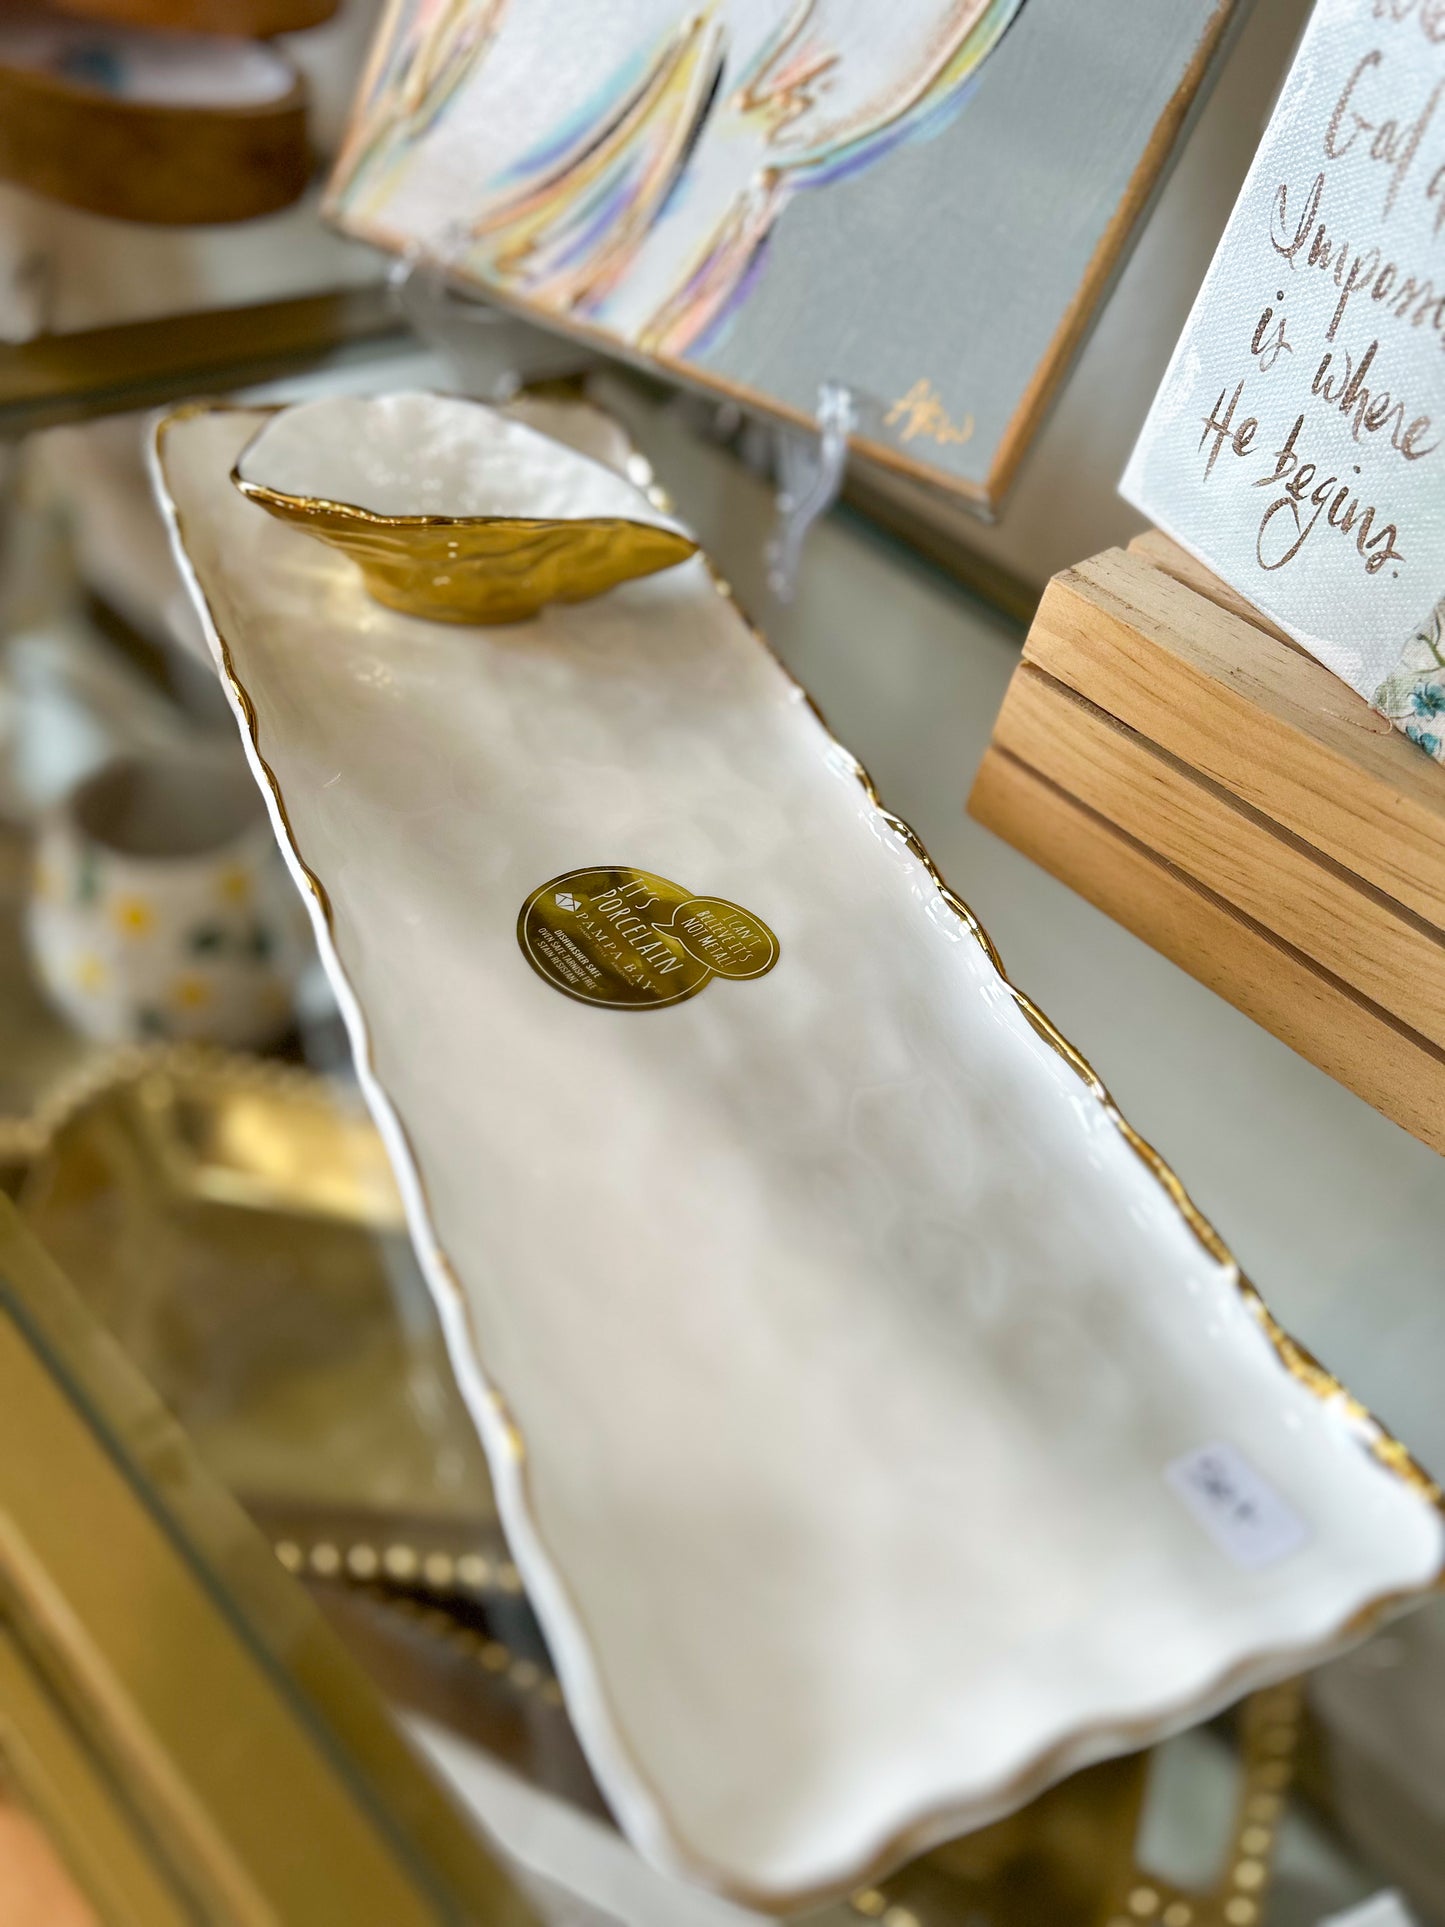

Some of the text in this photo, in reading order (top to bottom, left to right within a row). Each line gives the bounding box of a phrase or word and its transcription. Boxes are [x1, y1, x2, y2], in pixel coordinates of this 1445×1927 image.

[1251, 290, 1441, 461] is where
[1198, 379, 1407, 579] He begins.
[618, 878, 660, 910] IT'S
[554, 929, 602, 978] DISHWASHER SAFE
[575, 912, 652, 990] PAMPA BAY
[590, 889, 684, 975] PORCELAIN
[681, 917, 737, 968] NOT METAL!
[696, 910, 754, 962] BELIEVE IT'S
[729, 920, 761, 947] CAN'T
[537, 940, 580, 984] STAIN RESISTANT
[538, 927, 555, 943] OVEN
[582, 975, 598, 990] FREE
